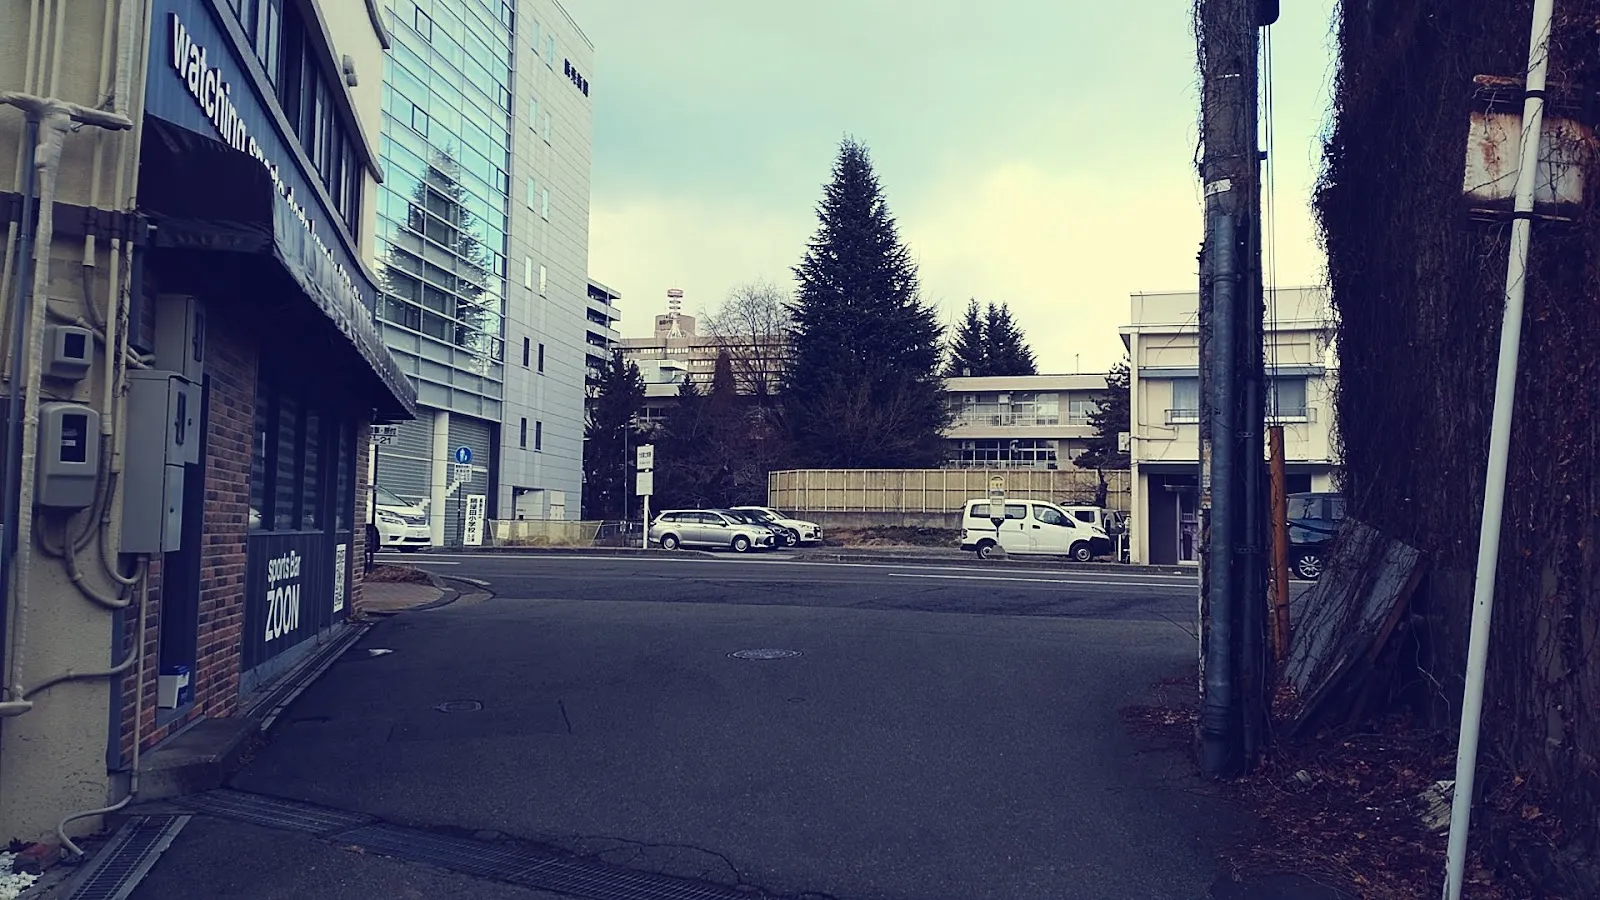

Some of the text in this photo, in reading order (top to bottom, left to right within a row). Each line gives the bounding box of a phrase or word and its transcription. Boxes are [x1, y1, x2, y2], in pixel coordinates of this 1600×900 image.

[268, 553, 290, 590] sports
[290, 550, 301, 578] Bar
[265, 584, 300, 642] ZOON
